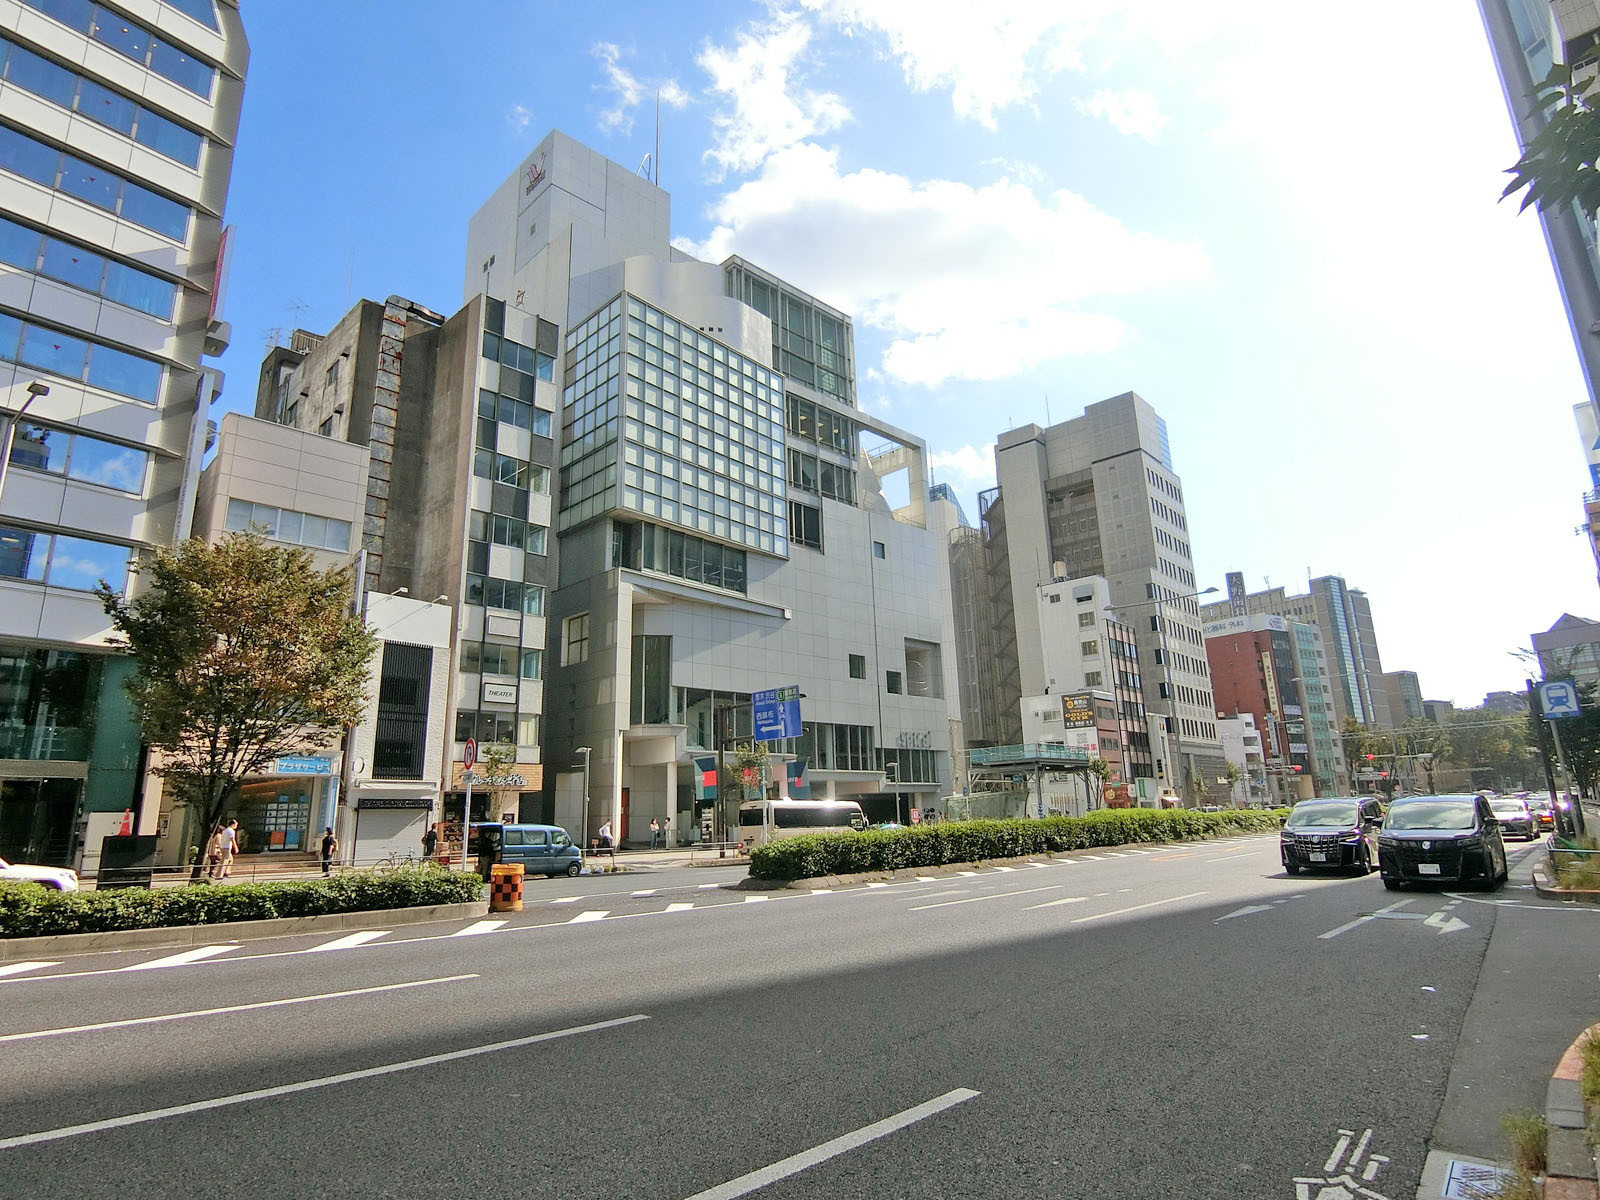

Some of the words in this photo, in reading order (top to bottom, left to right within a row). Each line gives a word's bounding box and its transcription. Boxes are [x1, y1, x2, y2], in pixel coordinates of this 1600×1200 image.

[488, 689, 513, 697] THEATER
[280, 762, 330, 771] プラザサービス
